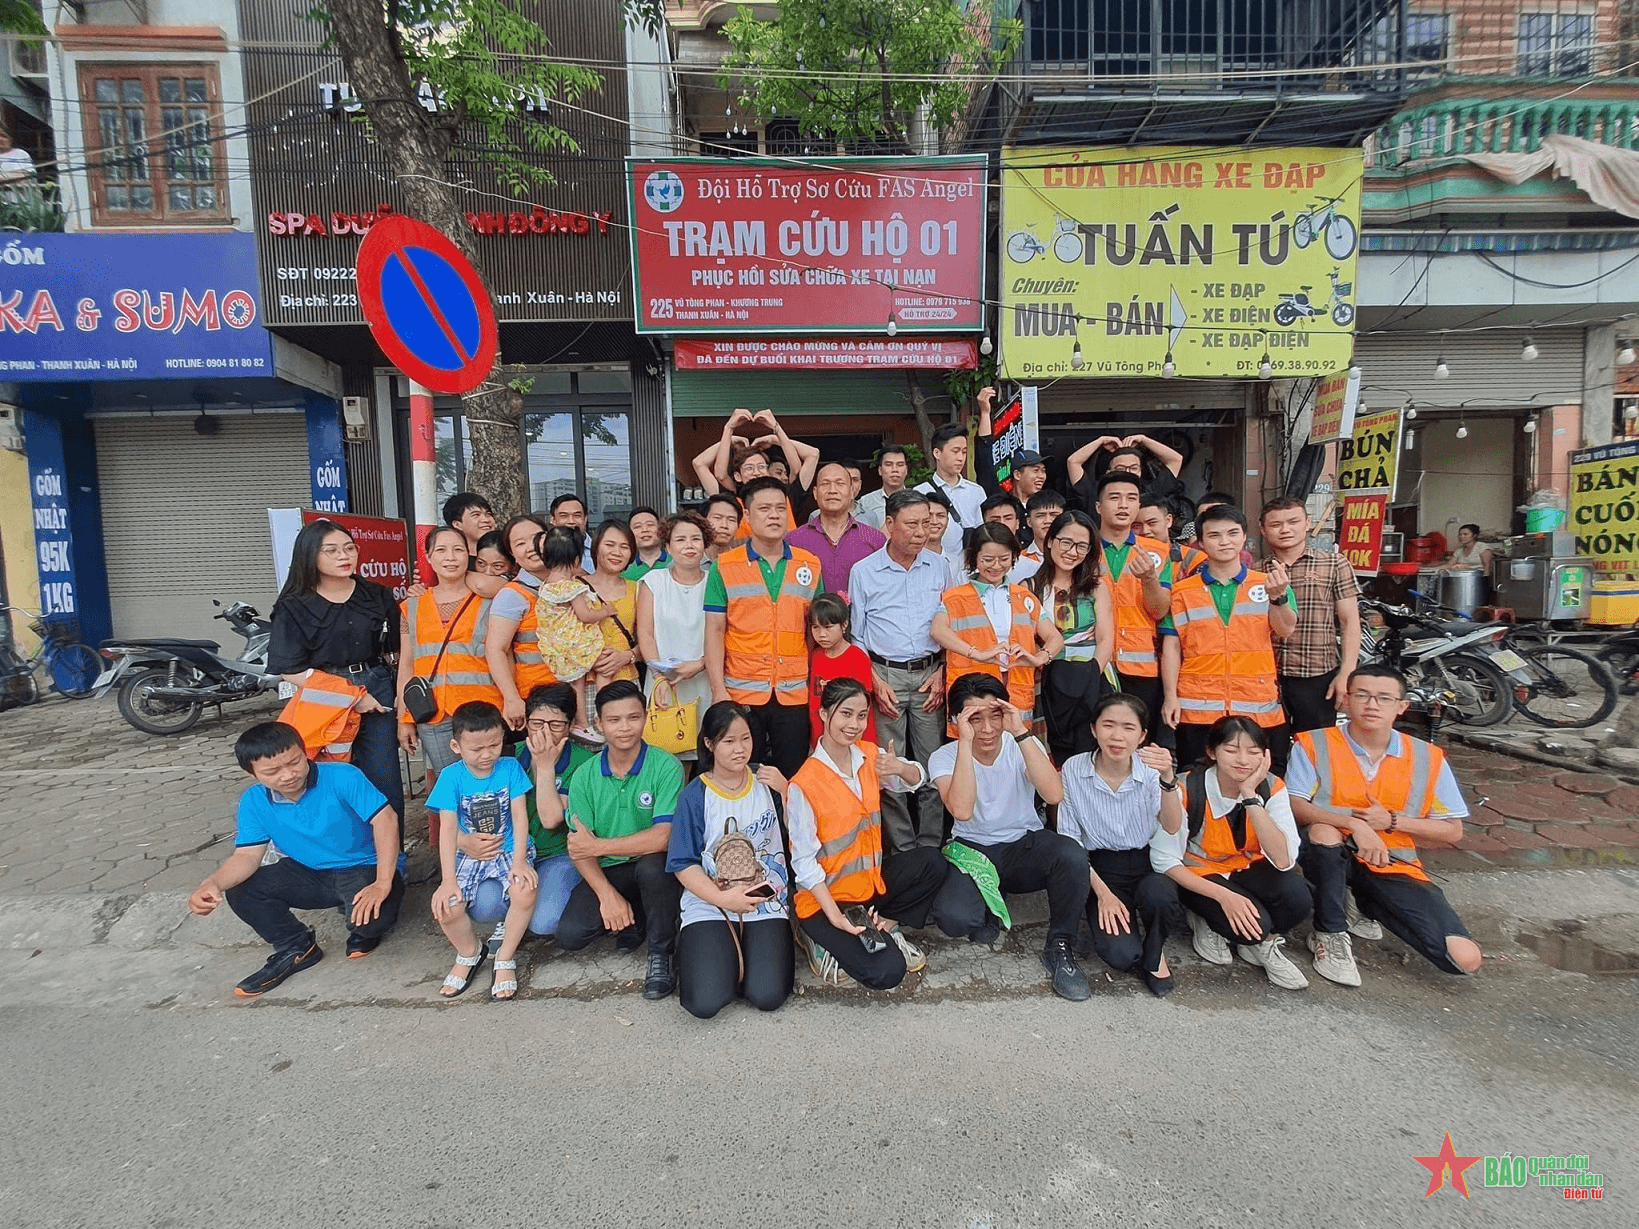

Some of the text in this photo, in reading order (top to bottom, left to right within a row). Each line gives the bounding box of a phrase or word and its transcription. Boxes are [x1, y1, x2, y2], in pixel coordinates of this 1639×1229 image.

[1043, 154, 1326, 194] CỬA HÀNG XE ĐẠP
[697, 174, 973, 204] Đội Hỗ Trợ Sơ Cứu FAS Angel
[268, 210, 327, 236] SPA
[593, 210, 613, 234] Y
[663, 210, 957, 265] TRẠM CỨU HỘ 01
[1077, 203, 1290, 266] TUẤN TÚ
[0, 239, 46, 265] ỐM
[277, 267, 357, 280] SĐT 09222
[691, 270, 734, 289] PHỤC
[738, 264, 765, 286] HỒI
[769, 263, 801, 286] SỬA
[805, 265, 847, 286] CHỮA
[851, 269, 870, 285] XE
[903, 269, 936, 288] NẠN
[1012, 277, 1080, 295] Chuyên:
[1203, 283, 1266, 301] XE ĐẠP
[280, 294, 303, 309] Địa
[332, 294, 358, 307] 223
[497, 291, 521, 304] anh
[527, 291, 565, 305] Xuân
[575, 291, 594, 304] Hà
[597, 291, 621, 306] Nội
[650, 298, 674, 319] 225
[705, 298, 725, 307] PHAN
[761, 298, 783, 307] TRUNG
[895, 297, 925, 306] HOTLINE:
[76, 298, 102, 332] &
[113, 287, 256, 335] SUMO
[675, 309, 749, 321] THANH XUÂN HÀ NỘI
[931, 310, 952, 318] 24/24
[1014, 294, 1164, 337] MUA BÁN
[1202, 305, 1271, 326] XE ĐIỆN
[714, 342, 733, 351] XIN
[736, 341, 767, 353] ĐƯỢC
[770, 340, 801, 351] CHÀO
[804, 340, 838, 351] MỪNG
[841, 340, 856, 351] VÀ
[887, 342, 905, 351] ƠN
[907, 340, 928, 352] QUÝ
[931, 343, 942, 353] VỊ
[1202, 330, 1309, 351] XE ĐẠP ĐIỆN
[9, 360, 35, 370] PHAN
[40, 360, 73, 370] THANH
[74, 358, 100, 370] XUÂN
[107, 358, 120, 369] HÀ
[121, 357, 138, 371] NỘI
[166, 358, 205, 369] HOTLINE:
[206, 358, 228, 369] 0904
[229, 358, 239, 368] 81
[241, 358, 252, 368] 80
[253, 358, 264, 368] 82
[696, 354, 713, 364] ĐÃ
[715, 353, 738, 364] ĐẾN
[741, 356, 758, 365] DỰ
[760, 353, 787, 364] BUỔI
[820, 355, 864, 364] TRƯƠNG
[867, 355, 899, 366] TRẠM
[901, 353, 924, 364] CỨU
[926, 353, 942, 366] HỘ
[944, 356, 958, 364] 01
[1023, 363, 1043, 377] Địa
[1046, 361, 1068, 373] chỉ:
[1097, 362, 1112, 372] Vũ
[1115, 361, 1144, 374] Tông
[1236, 361, 1254, 370] ĐT:
[1256, 360, 1336, 371] 069.38.90.92
[1340, 429, 1395, 461] BÚN
[36, 467, 62, 496] GỐM
[316, 459, 341, 488] GỐM
[1339, 456, 1389, 489] CHẢ
[34, 502, 67, 534] NHẬT
[1346, 499, 1379, 520] MÍA
[1575, 491, 1639, 525] CUỐ
[1347, 522, 1370, 543] ĐÁ
[1575, 528, 1639, 555] NÓN
[40, 541, 71, 572] 95K
[1342, 549, 1373, 567] 10K
[360, 557, 407, 580] CỨU HỘ
[43, 582, 74, 613] 1KG
[392, 580, 407, 600] SỐ
[473, 808, 499, 818] JEANS
